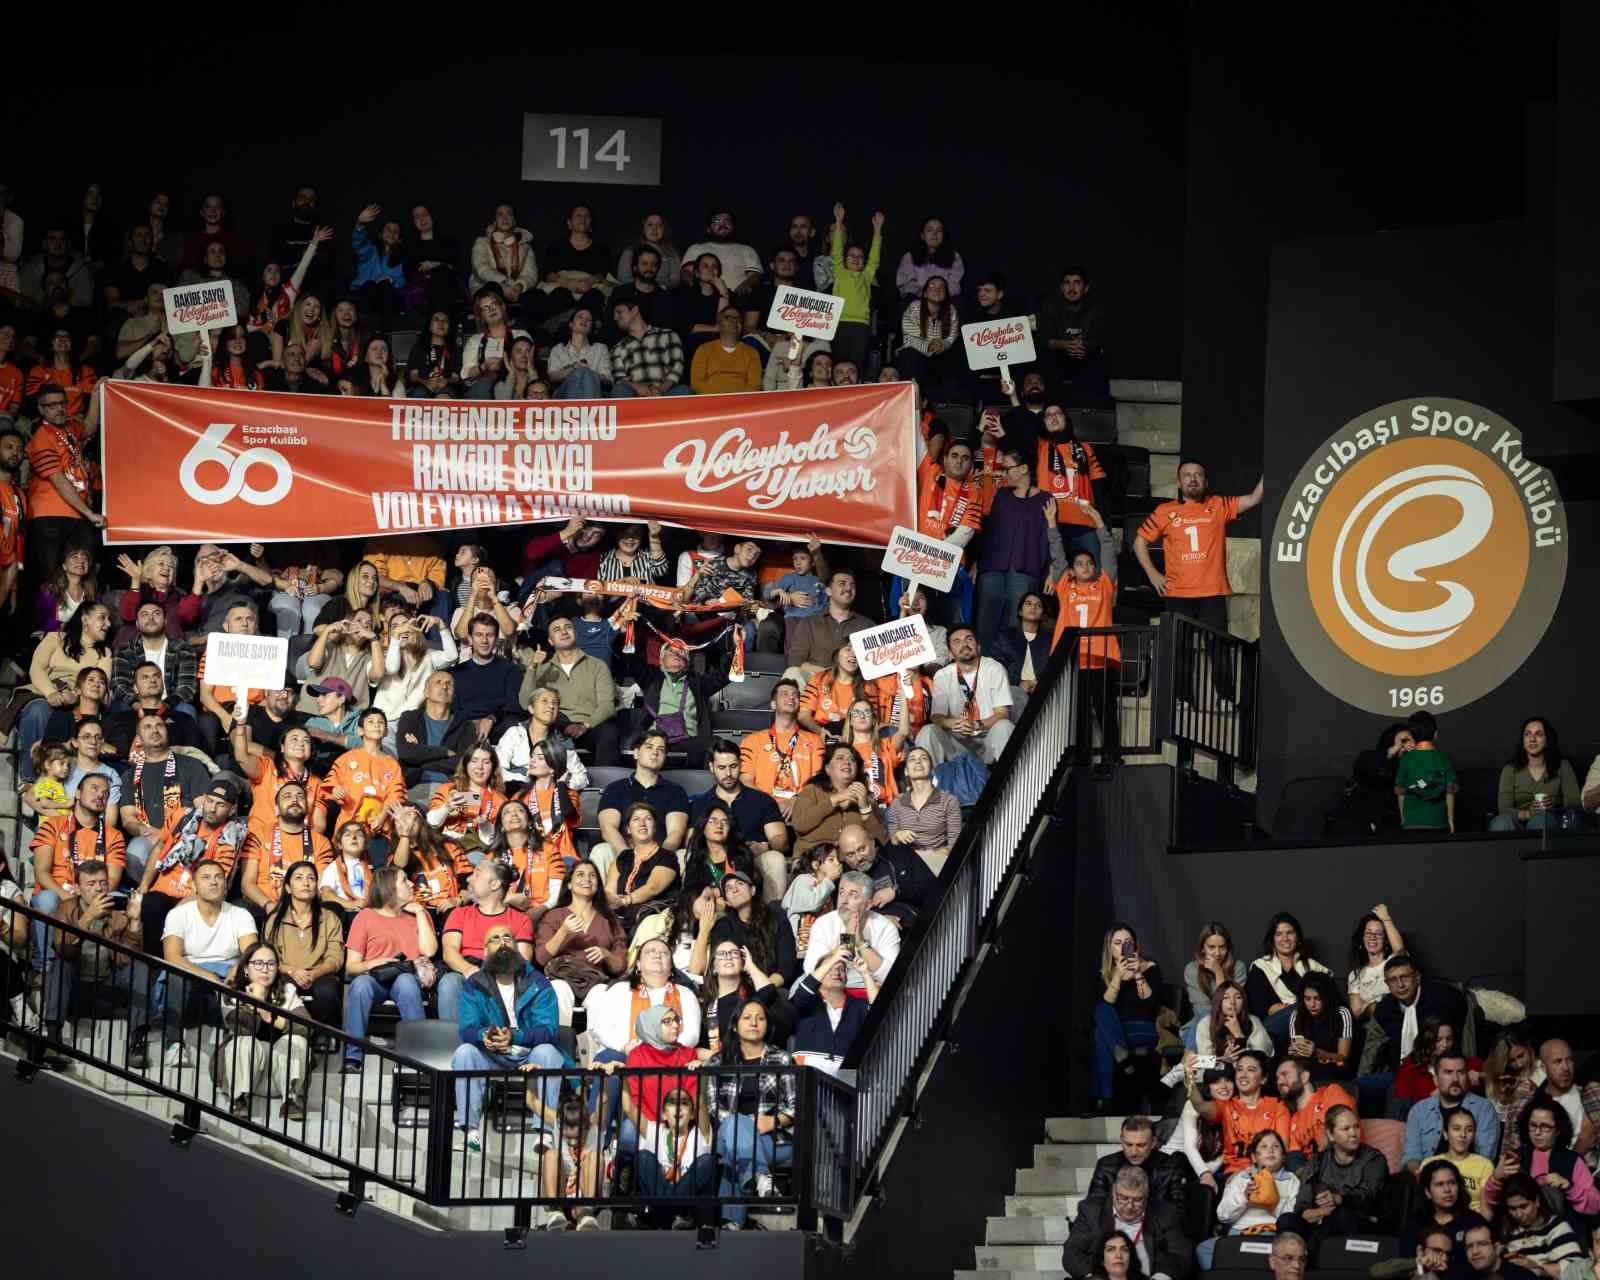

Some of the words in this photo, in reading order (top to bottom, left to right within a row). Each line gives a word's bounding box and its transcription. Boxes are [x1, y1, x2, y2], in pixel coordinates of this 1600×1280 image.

[549, 127, 631, 171] 114
[242, 425, 297, 436] Eczacıbaşı
[243, 435, 268, 446] Spor
[270, 436, 308, 446] Kulübü
[525, 405, 617, 442] COŞKU
[514, 443, 593, 491] SAYGI
[663, 423, 838, 493] Voleybola
[747, 464, 876, 510] Yakışır
[1277, 415, 1399, 562] Eczacıbaşı
[1411, 405, 1490, 441] Spor
[1491, 431, 1562, 547] Kulübü
[1184, 526, 1199, 552] 1
[1075, 604, 1088, 628] 1
[1389, 686, 1444, 707] 1966
